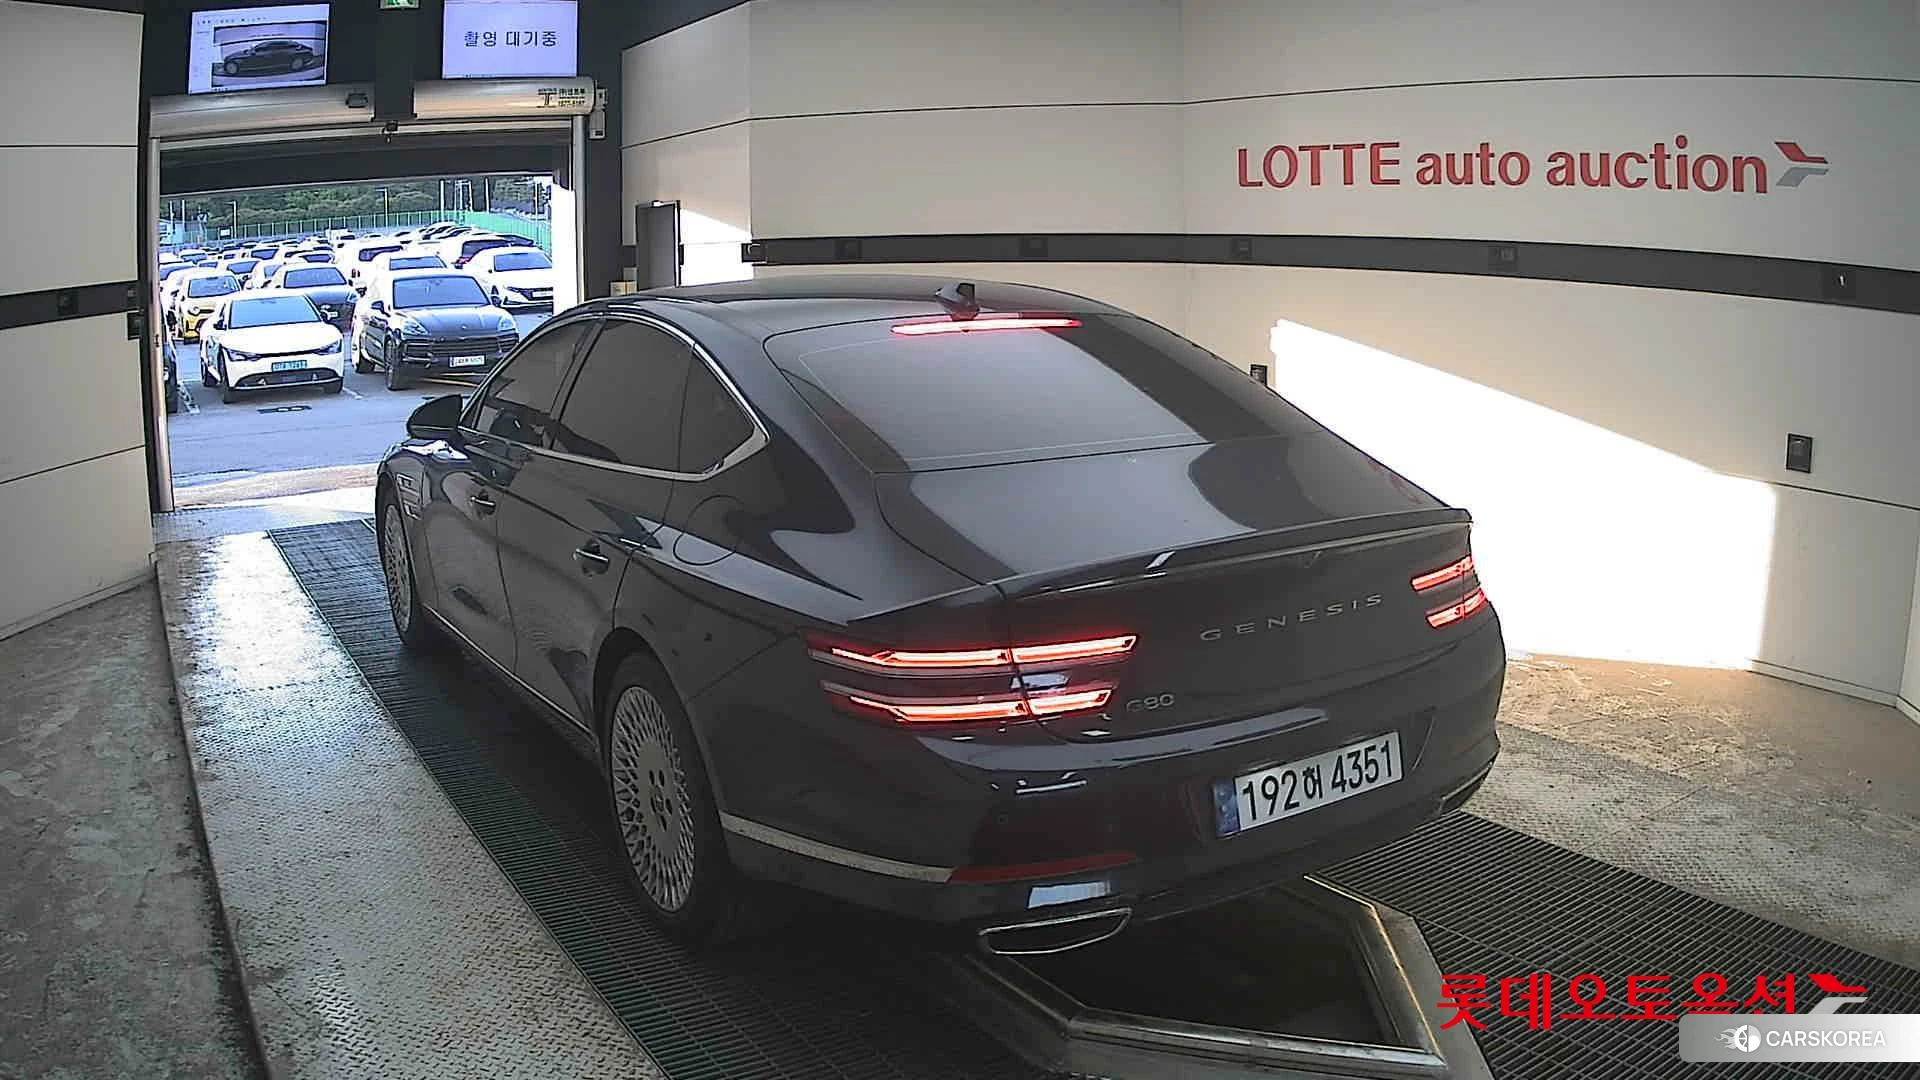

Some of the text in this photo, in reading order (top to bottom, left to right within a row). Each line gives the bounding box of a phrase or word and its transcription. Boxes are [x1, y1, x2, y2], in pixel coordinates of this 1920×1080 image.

[464, 30, 558, 48] 촬영 대기중
[1238, 135, 1768, 194] LOTTE auto auction
[1200, 593, 1384, 642] GENESIS
[1332, 739, 1393, 794] 4351
